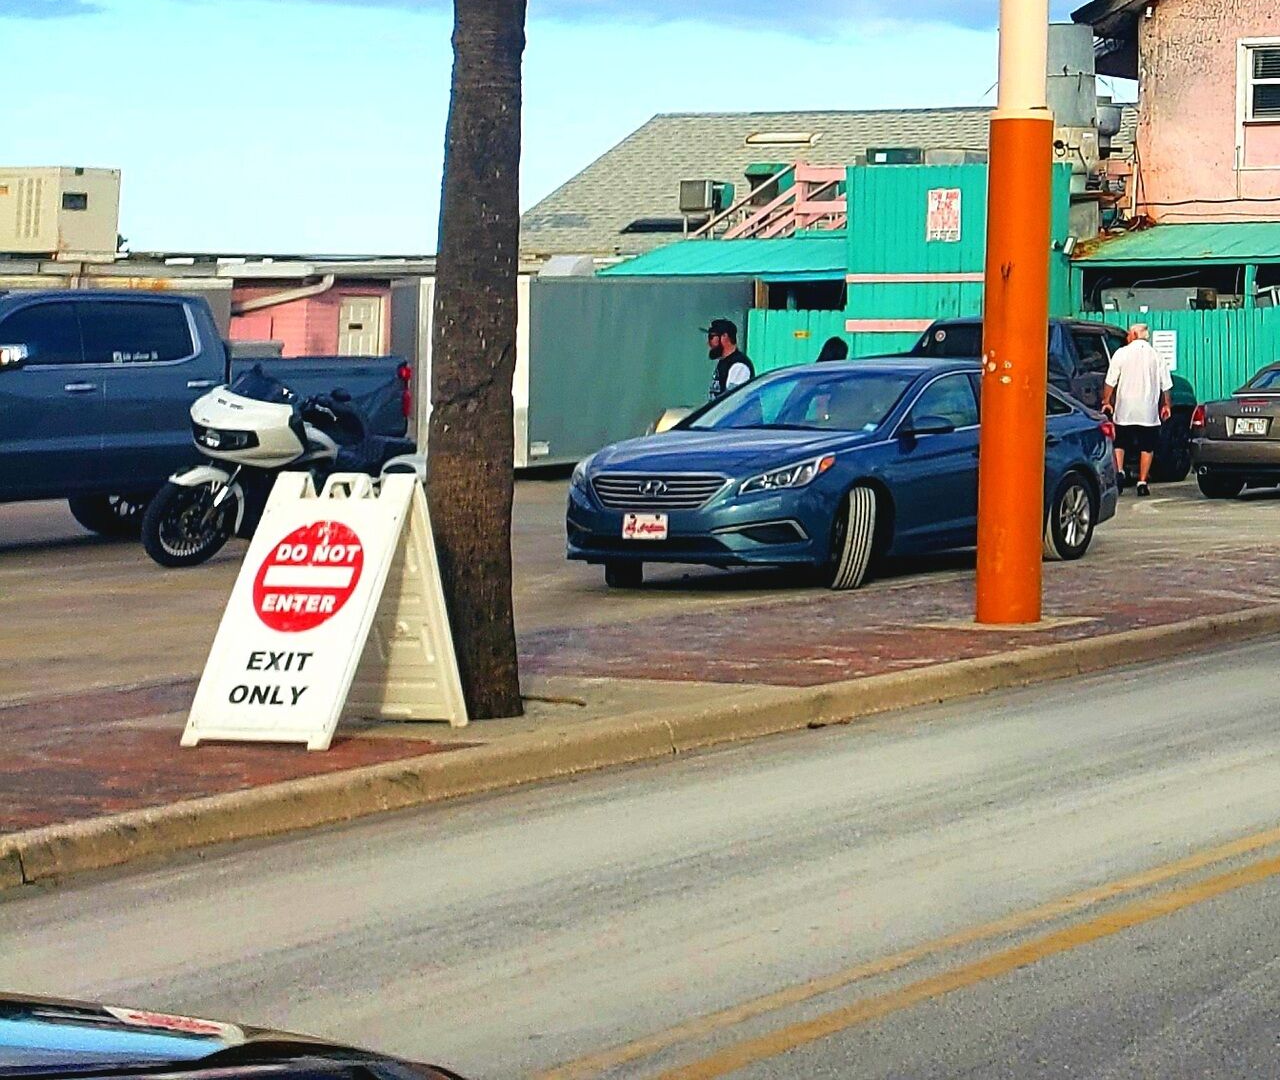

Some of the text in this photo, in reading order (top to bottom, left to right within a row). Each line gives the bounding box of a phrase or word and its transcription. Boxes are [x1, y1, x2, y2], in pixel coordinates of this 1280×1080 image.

[275, 543, 361, 562] DO NOT
[261, 593, 336, 613] ENTER
[246, 651, 314, 671] EXIT
[228, 684, 308, 705] ONLY
